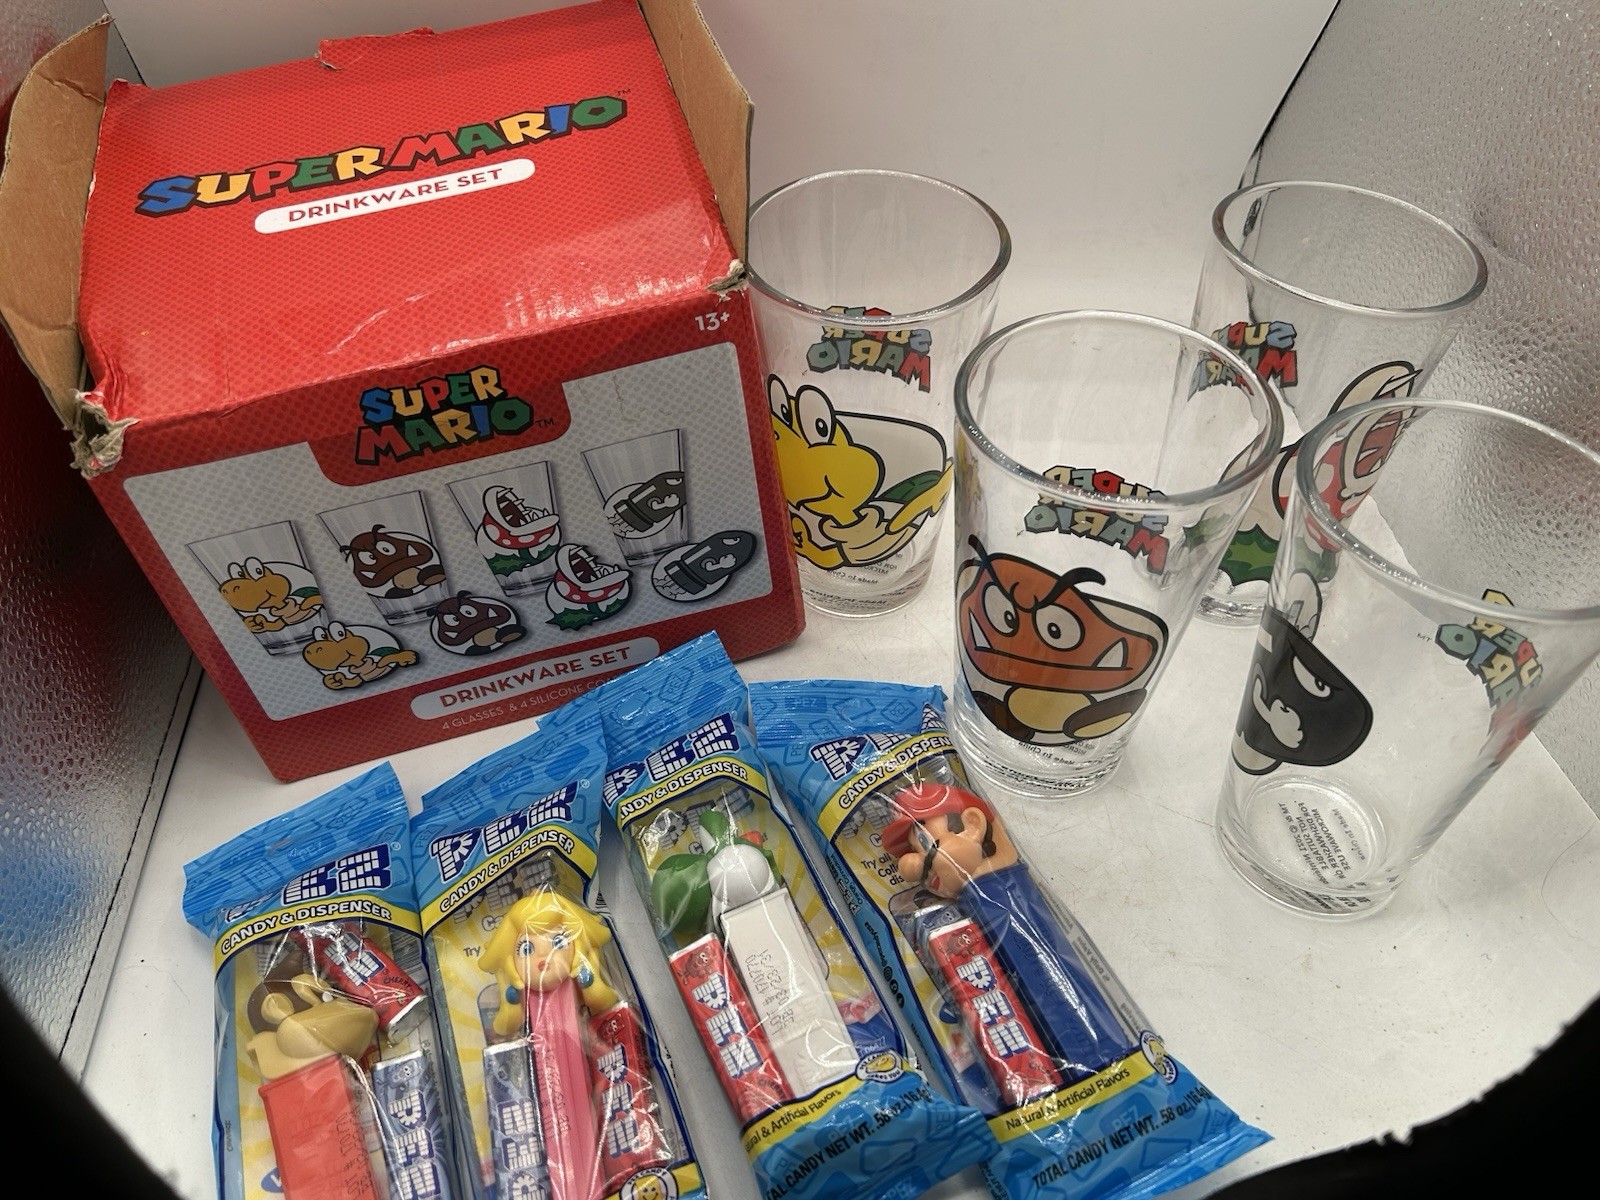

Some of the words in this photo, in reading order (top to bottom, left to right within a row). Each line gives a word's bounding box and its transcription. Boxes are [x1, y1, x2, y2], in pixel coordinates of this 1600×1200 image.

[135, 146, 385, 217] SUPER
[385, 96, 627, 171] MARIO
[289, 180, 449, 222] DRINKWARE
[458, 168, 503, 188] SET
[694, 311, 730, 331] 13+
[359, 364, 505, 424] SUPER
[355, 396, 534, 465] MARIO
[535, 417, 555, 428] TM
[439, 659, 584, 708] DRINKWARE
[590, 647, 630, 667] SET
[441, 721, 450, 730] 4
[452, 706, 505, 727] GLASSES
[509, 703, 517, 712] &
[520, 700, 528, 709] 4
[530, 684, 585, 706] SILICONE
[656, 785, 669, 799] &
[668, 761, 748, 797] DISPENSER
[839, 766, 886, 809] CANDY
[898, 736, 953, 767] DISPEN
[429, 780, 580, 884] PEZ
[860, 859, 878, 871] Try
[878, 853, 892, 864] all
[439, 870, 486, 913] CANDY
[488, 863, 499, 877] &
[499, 829, 575, 869] DISPENSER
[220, 917, 279, 955] CANDY
[280, 912, 295, 926] &
[296, 899, 392, 922] DISPENSER
[463, 945, 481, 958] Try
[691, 972, 764, 1080] PEZ
[956, 954, 1032, 1058] PEZ
[597, 1043, 640, 1159] PEZ
[761, 1125, 772, 1138] &
[771, 1107, 809, 1133] Artificial
[808, 1089, 842, 1114] Flavors
[1005, 1111, 1047, 1131] Natural
[1056, 1084, 1098, 1111] Artificial
[1096, 1067, 1131, 1092] Flavors
[388, 1087, 442, 1200] PEZ
[785, 1151, 827, 1188] CANDY
[825, 1135, 851, 1159] NET
[1032, 1163, 1069, 1190] TOTAL
[1067, 1141, 1110, 1170] CANDY
[1109, 1128, 1135, 1150] NET
